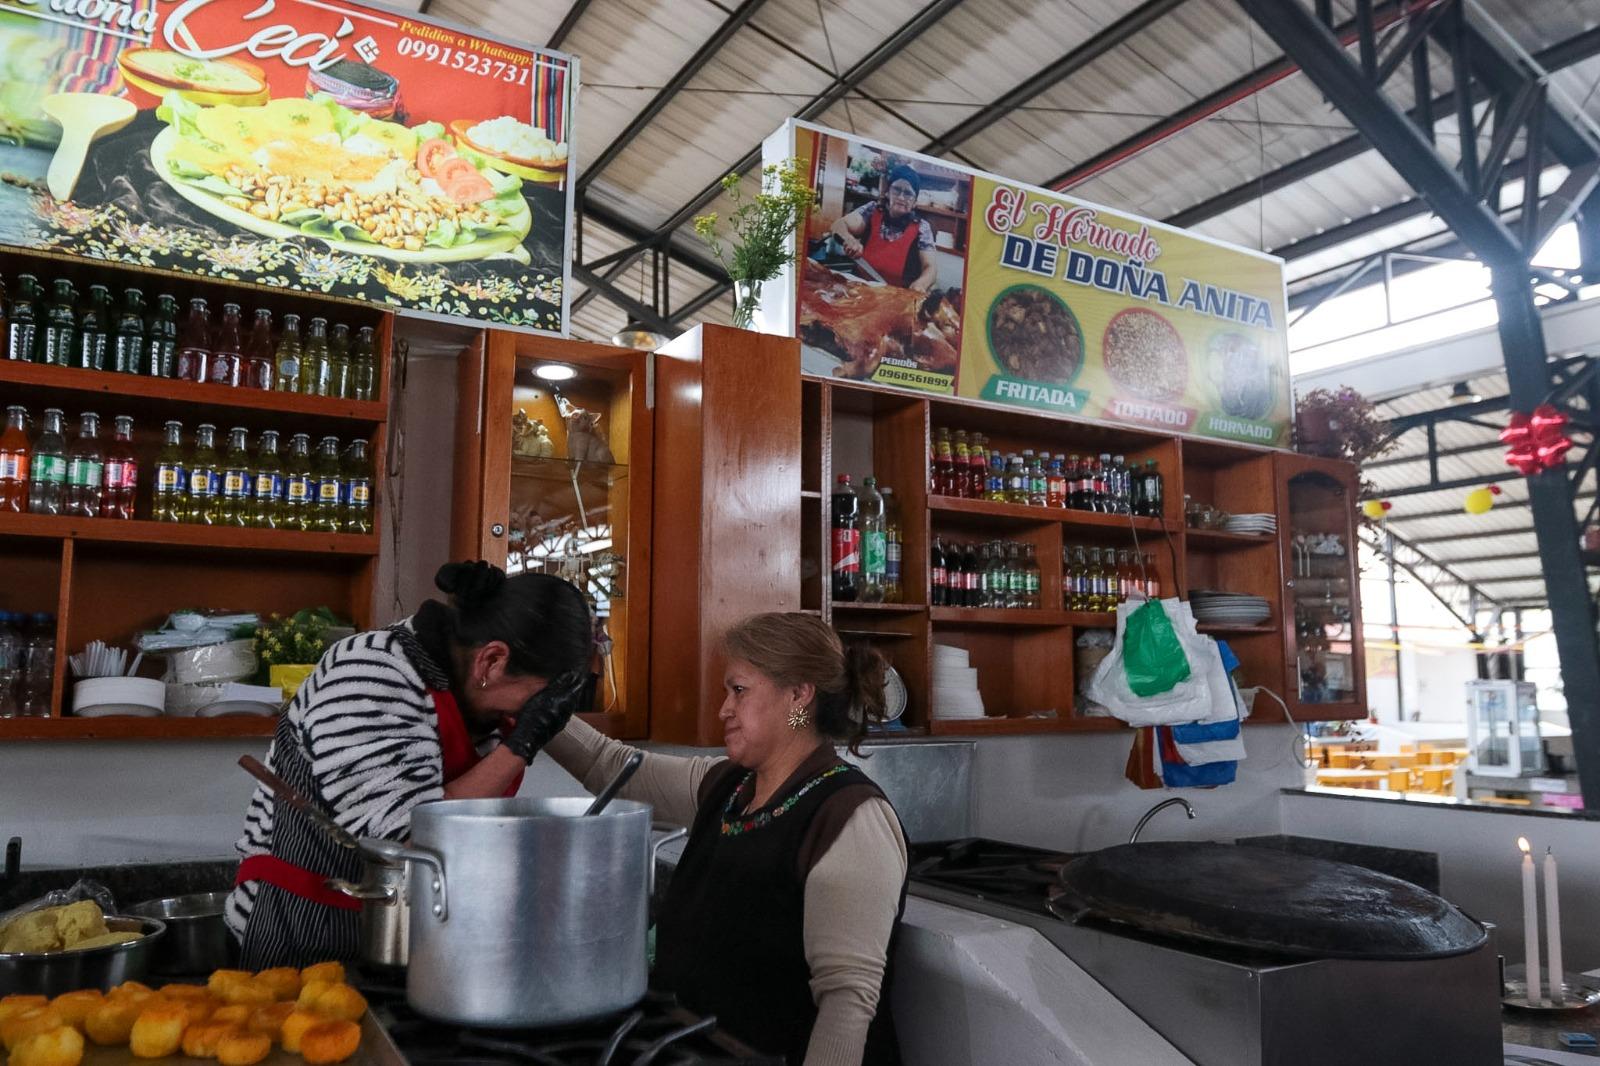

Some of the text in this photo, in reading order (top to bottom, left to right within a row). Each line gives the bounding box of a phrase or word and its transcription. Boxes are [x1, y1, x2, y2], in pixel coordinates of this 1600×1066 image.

[163, 0, 354, 72] Ceci
[400, 20, 455, 44] Pedidios
[457, 37, 466, 48] a
[397, 36, 530, 86] 0991523731
[985, 187, 1161, 262] El Hornado
[1001, 233, 1276, 331] DE DOÑA ANITA
[878, 368, 950, 387] 0968561899
[995, 380, 1077, 408] FRITADA
[1112, 400, 1188, 427] TOSTADO
[1208, 416, 1274, 440] HORNADO
